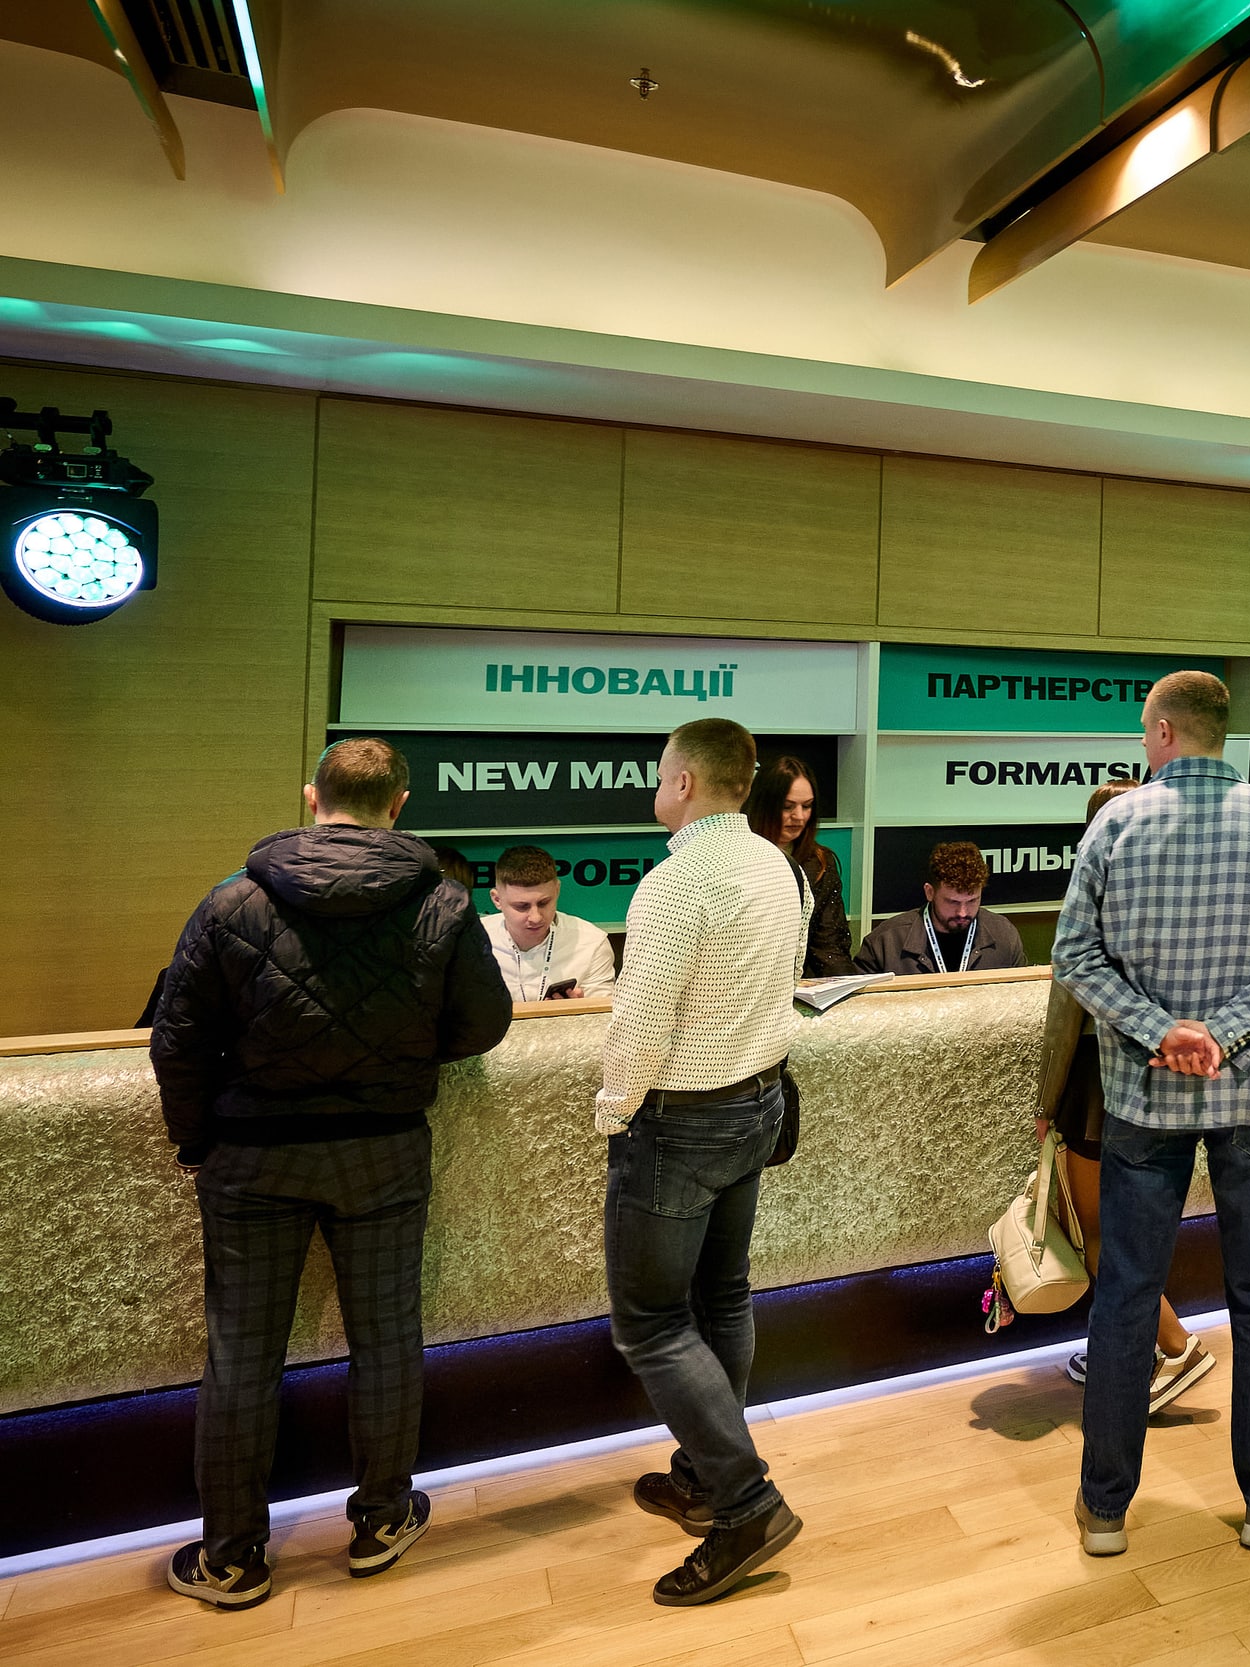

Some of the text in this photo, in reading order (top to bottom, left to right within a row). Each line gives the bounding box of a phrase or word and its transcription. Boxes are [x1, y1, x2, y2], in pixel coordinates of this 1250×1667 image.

[485, 663, 738, 702] ІННОВАЦІЇ
[927, 672, 1155, 703] ПАРТНЕРСТВ
[438, 761, 558, 792] NEW
[979, 845, 1078, 874] ПІЛЬН
